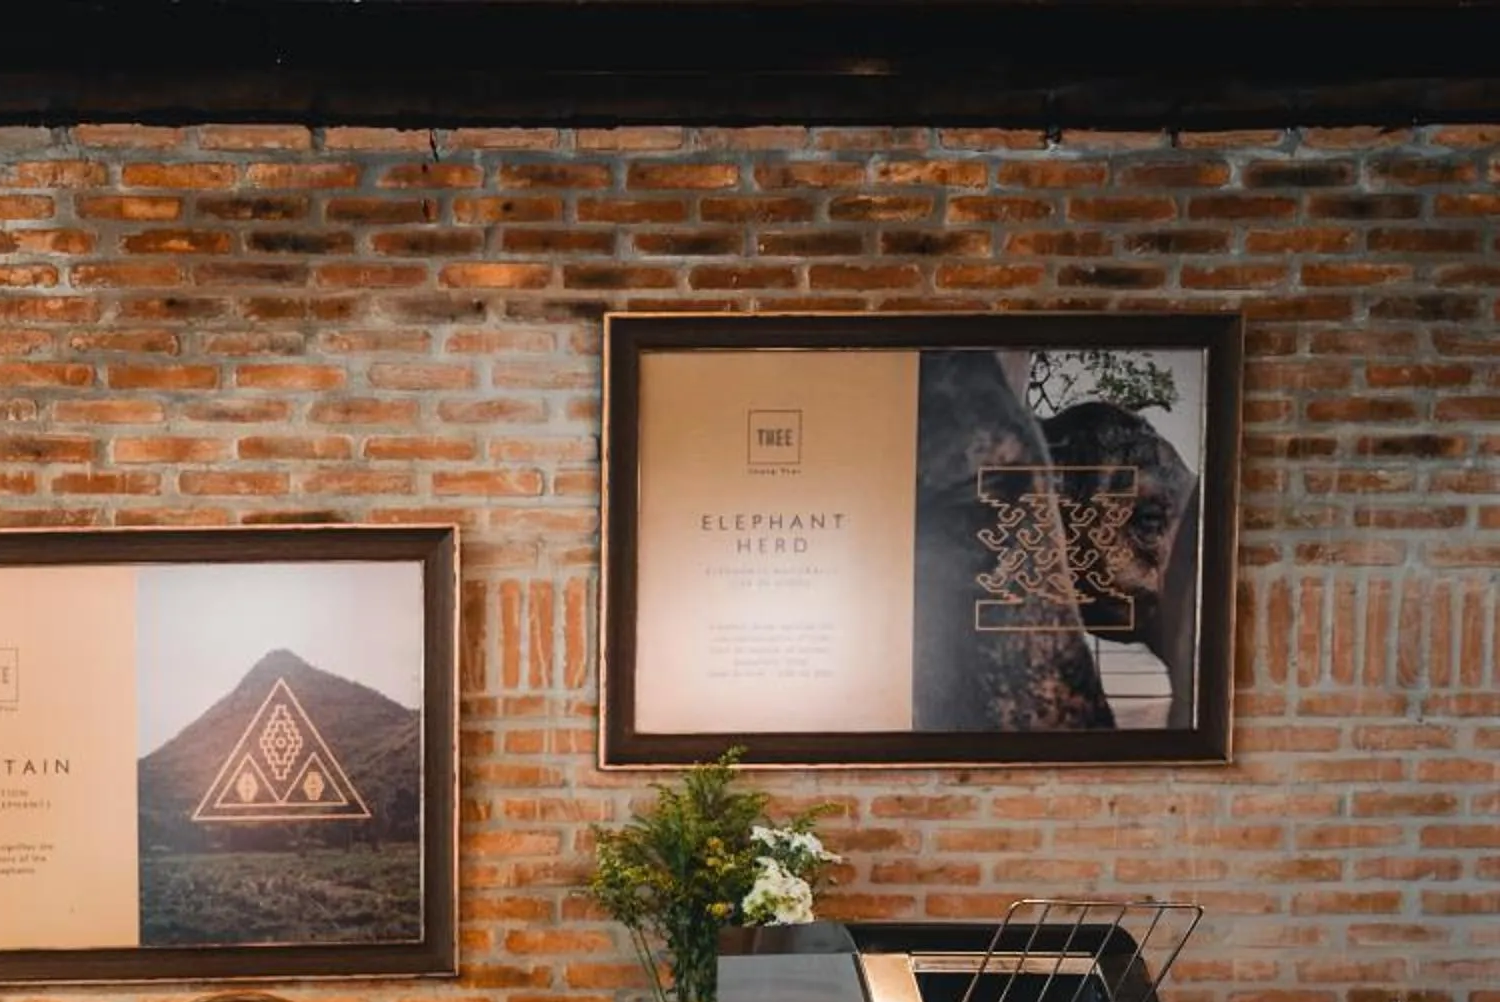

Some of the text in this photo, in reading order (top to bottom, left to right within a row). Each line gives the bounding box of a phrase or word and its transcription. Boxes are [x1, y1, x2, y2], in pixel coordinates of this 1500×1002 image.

[757, 428, 794, 447] THEE
[701, 512, 845, 531] ELEPHANT
[737, 536, 809, 554] HERD
